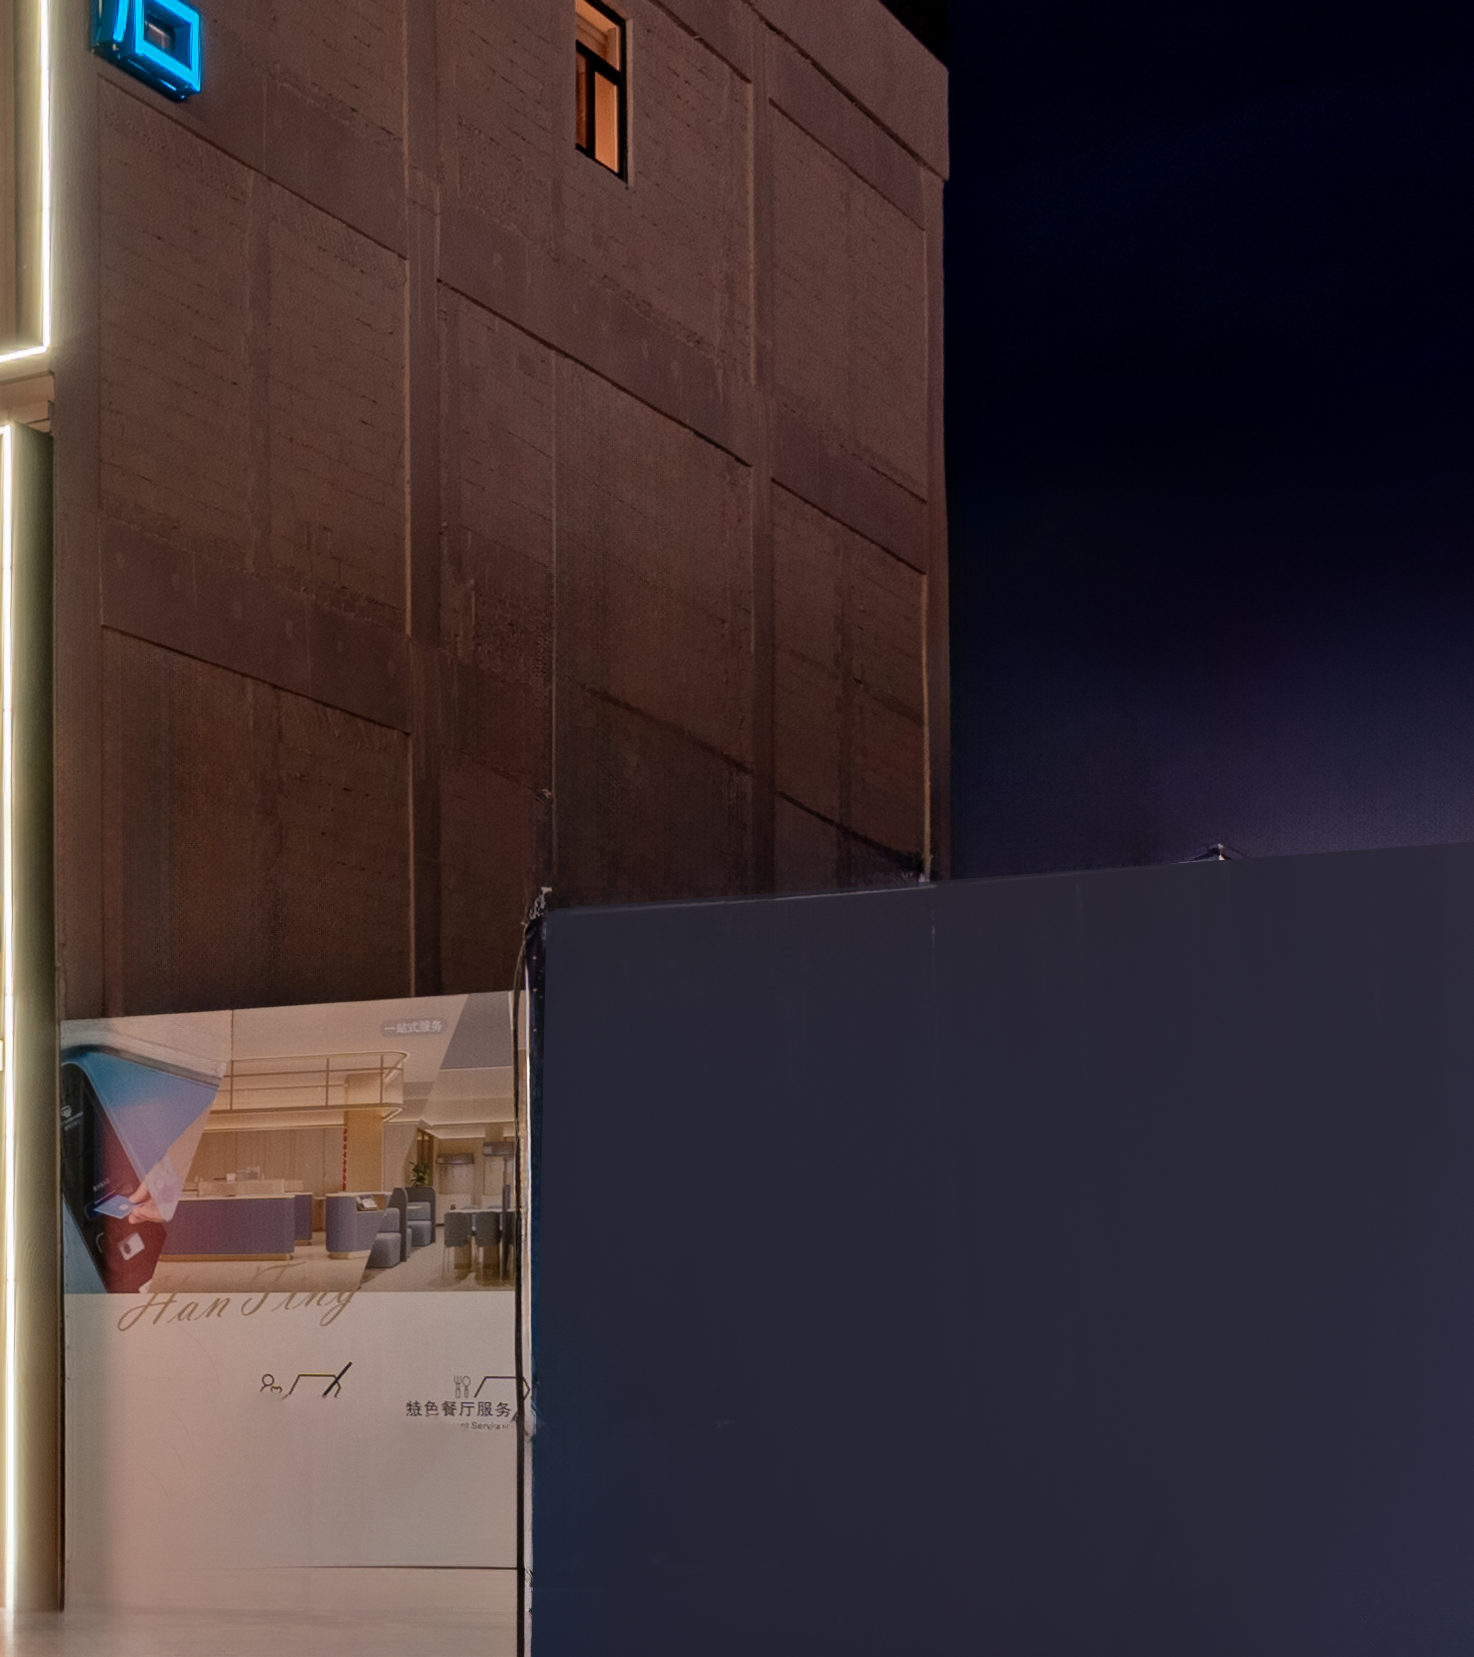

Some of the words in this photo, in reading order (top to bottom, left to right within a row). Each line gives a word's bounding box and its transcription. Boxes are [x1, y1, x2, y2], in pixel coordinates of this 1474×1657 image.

[384, 1020, 442, 1034] 一站式服务
[406, 1400, 512, 1418] 特色餐厅服务
